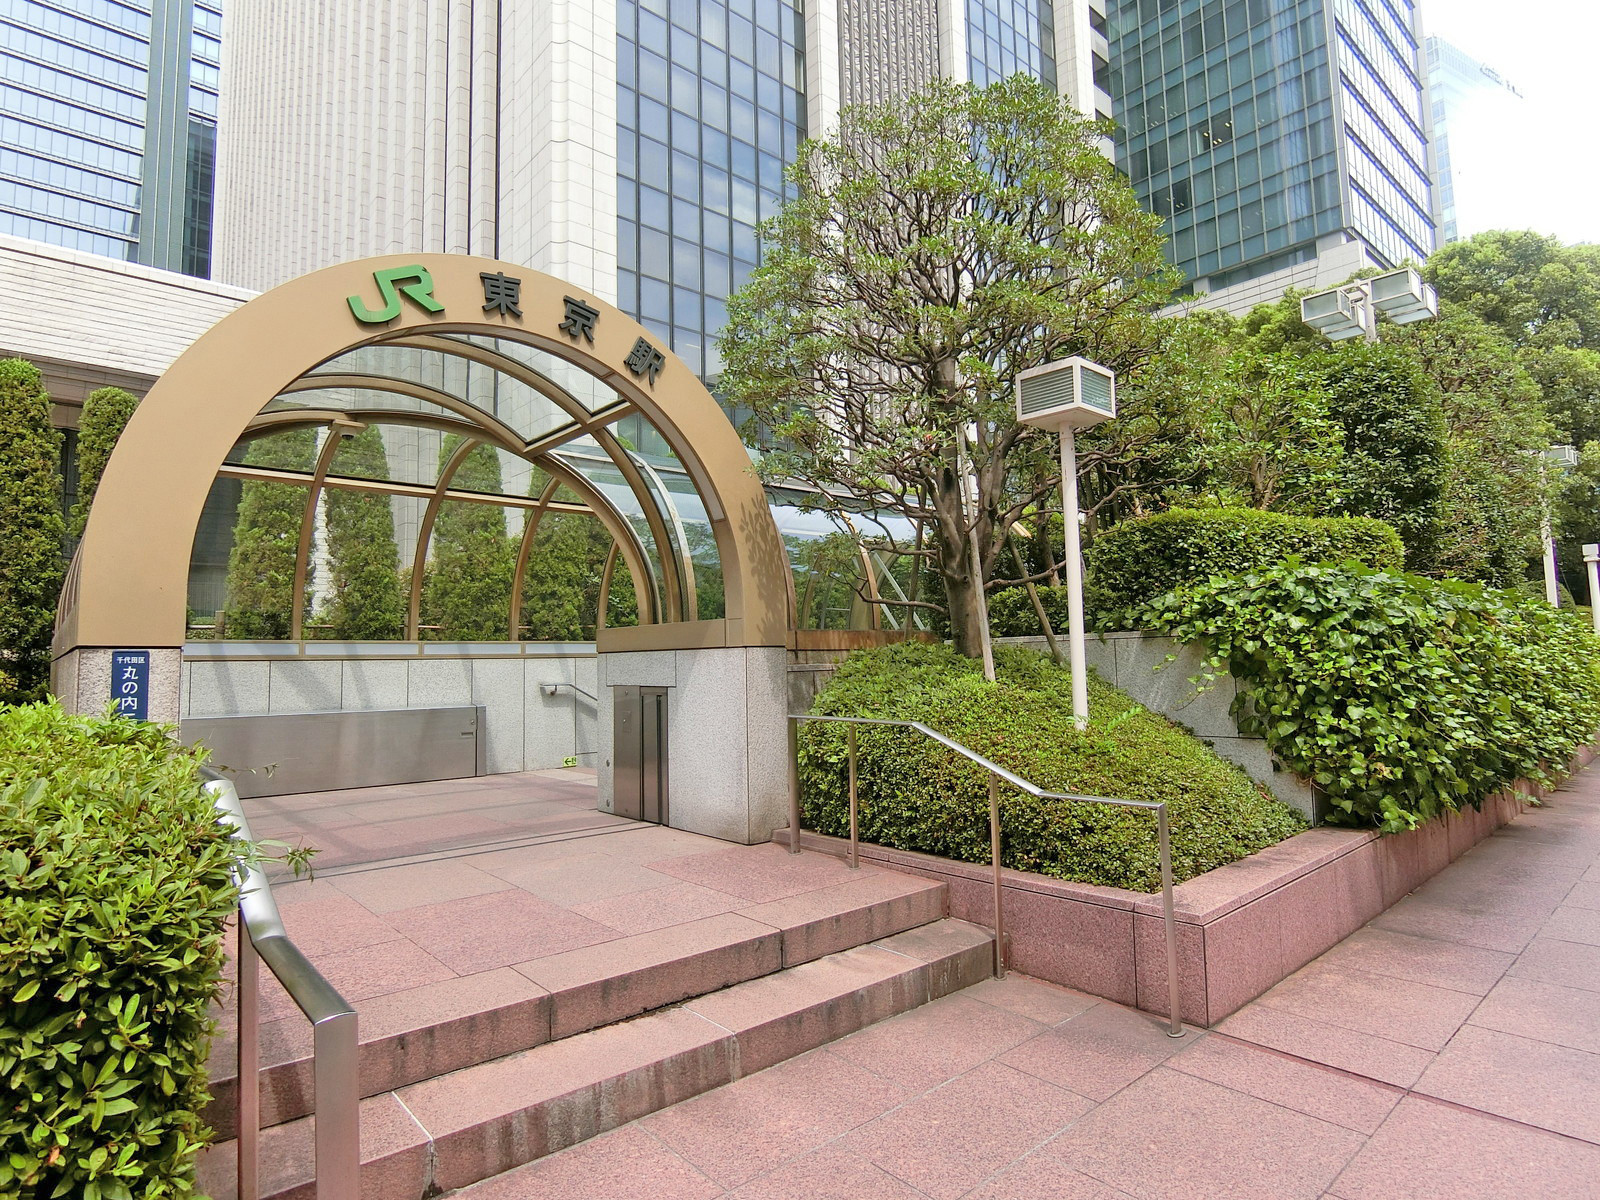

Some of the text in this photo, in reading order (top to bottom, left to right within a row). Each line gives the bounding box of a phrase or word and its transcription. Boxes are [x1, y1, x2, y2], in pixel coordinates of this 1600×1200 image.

[347, 264, 666, 386] JR 東京駅
[116, 656, 146, 664] 千代田区
